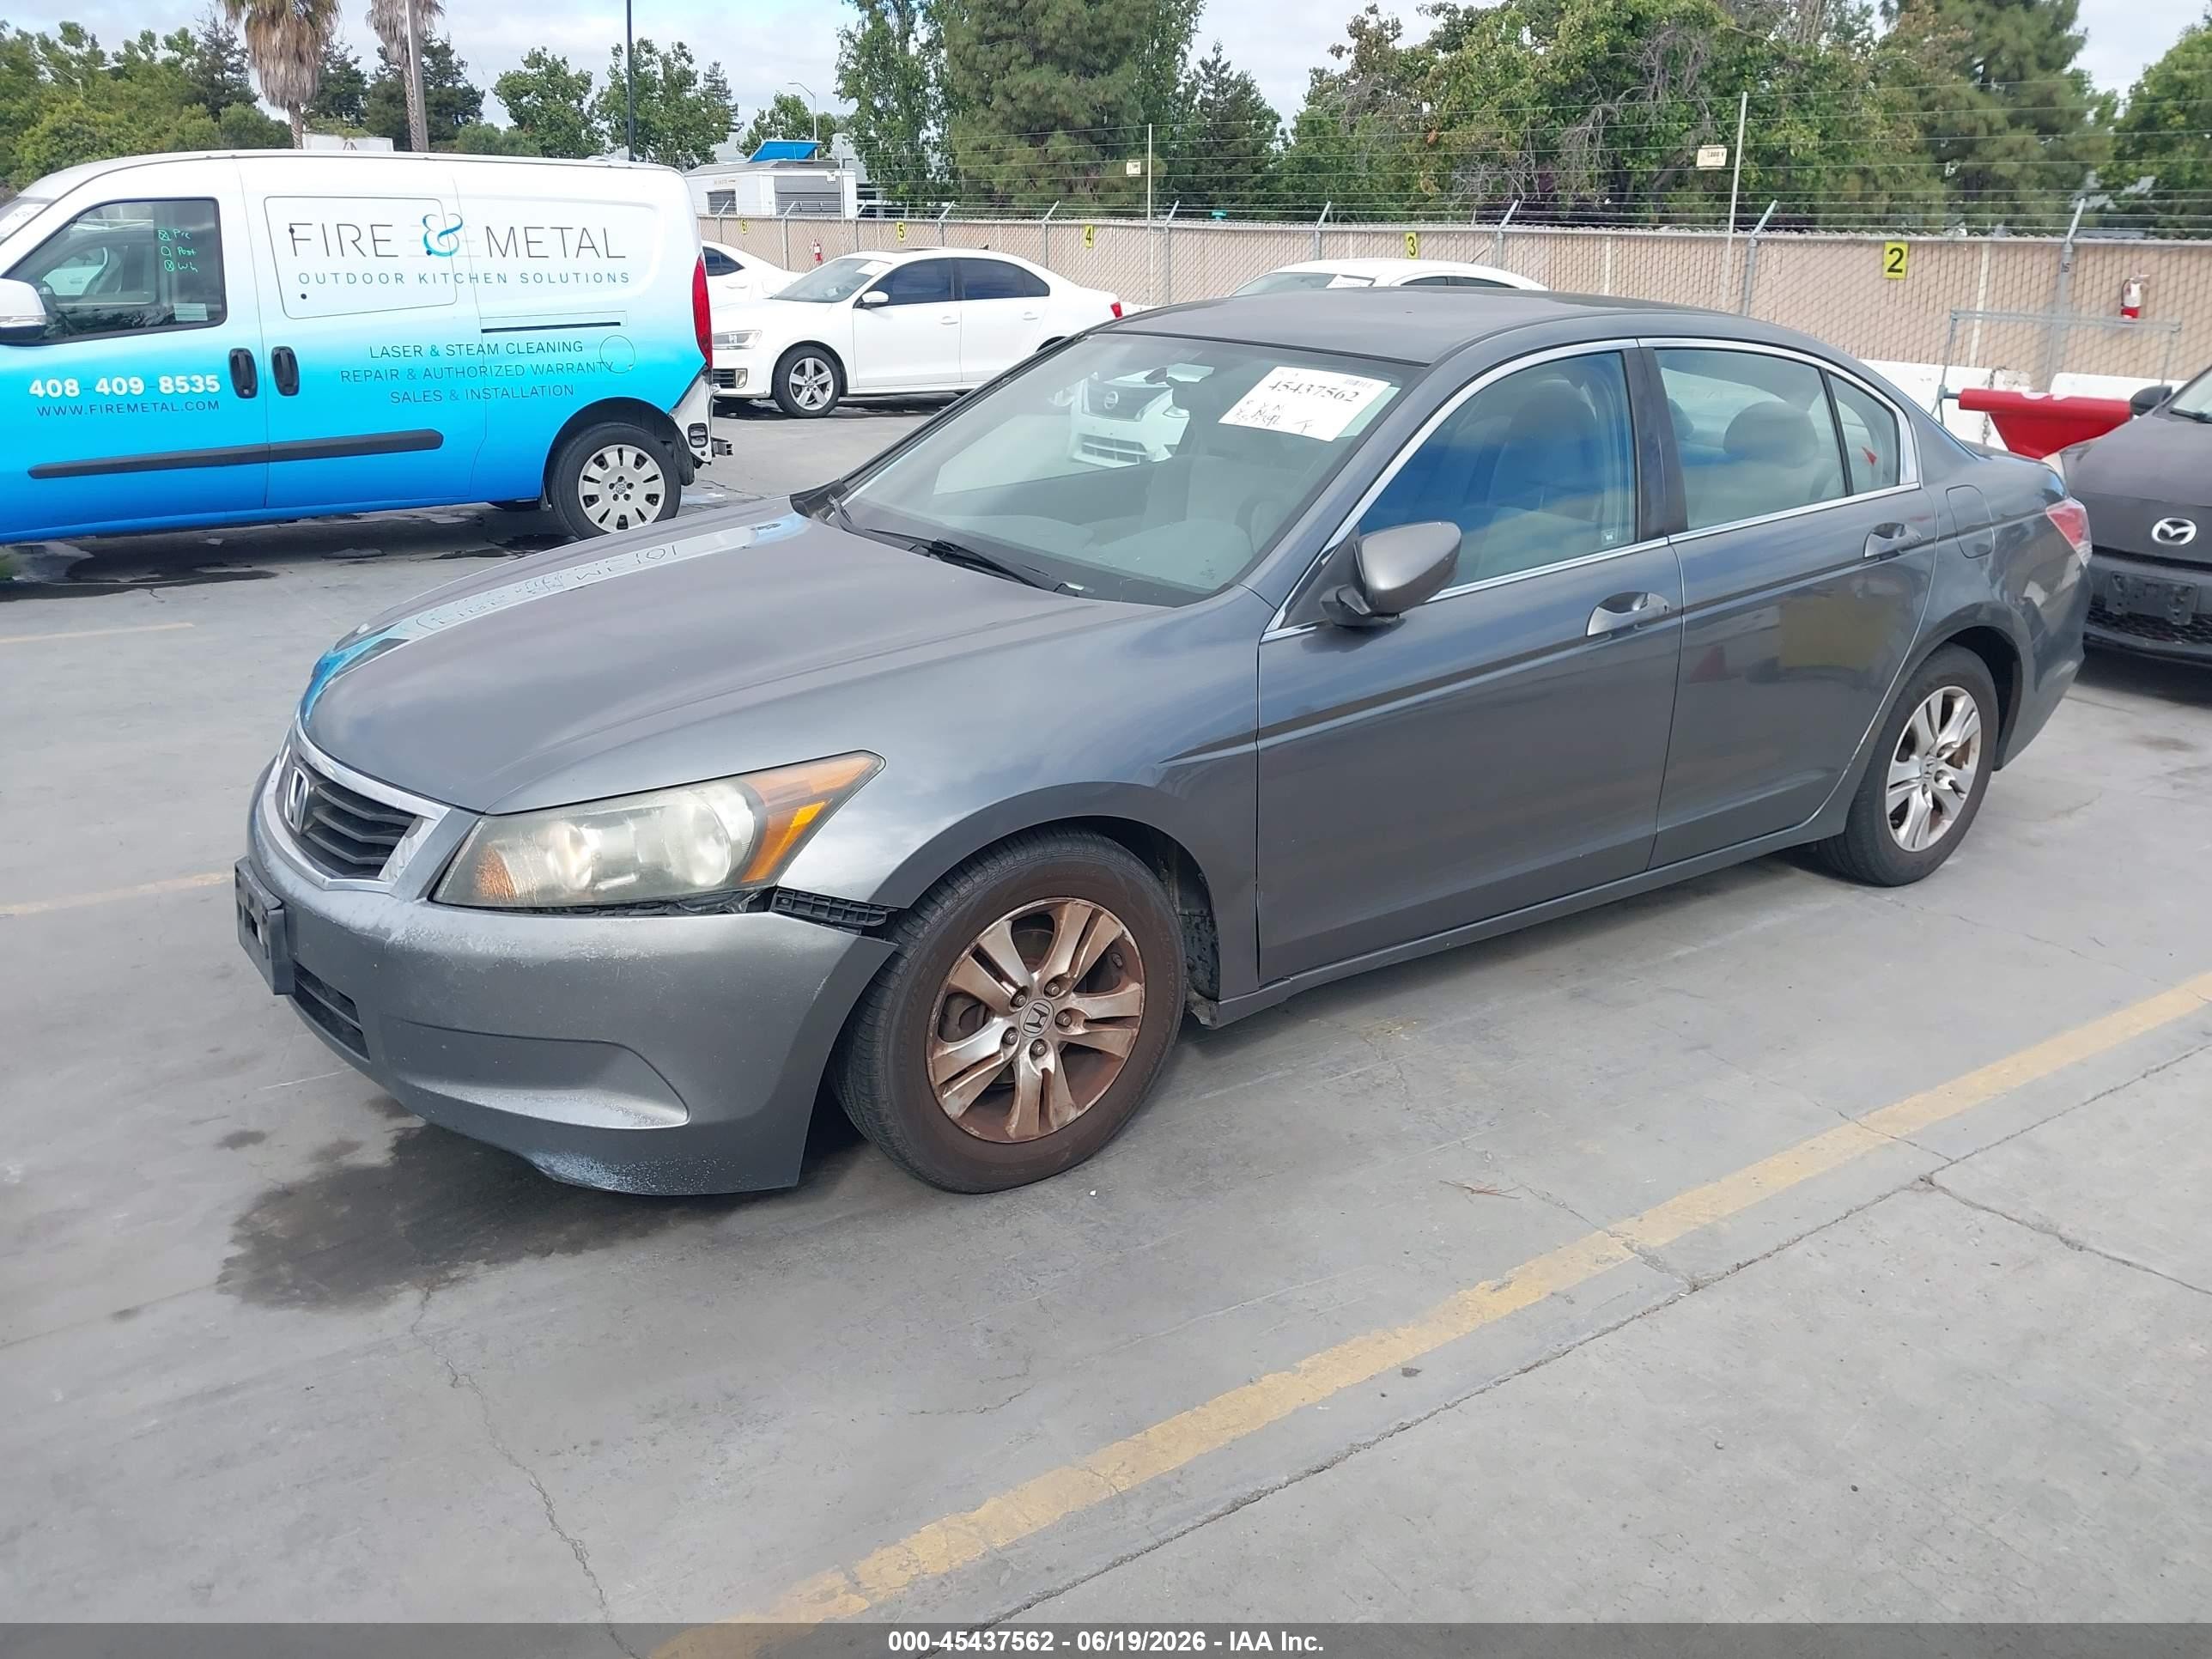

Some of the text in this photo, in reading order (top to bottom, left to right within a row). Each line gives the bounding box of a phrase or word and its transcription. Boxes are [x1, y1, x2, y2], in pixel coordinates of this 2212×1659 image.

[289, 213, 627, 258] FIRE & METAL
[898, 224, 905, 239] 5
[1085, 226, 1092, 245] 4
[1407, 235, 1417, 257] 3
[1887, 246, 1904, 273] 2
[298, 271, 630, 285] OUTDOOR KITCHEN SOLUTIONS
[369, 340, 584, 359] LASER & STEAM CLEANING
[340, 361, 614, 383] REPAIR & AUTHORIZED WARRANTY
[391, 384, 574, 404] SALES & INSTALLATION
[1268, 379, 1360, 403] 45437562
[36, 399, 221, 417] WWW.FIREMETAL.COM
